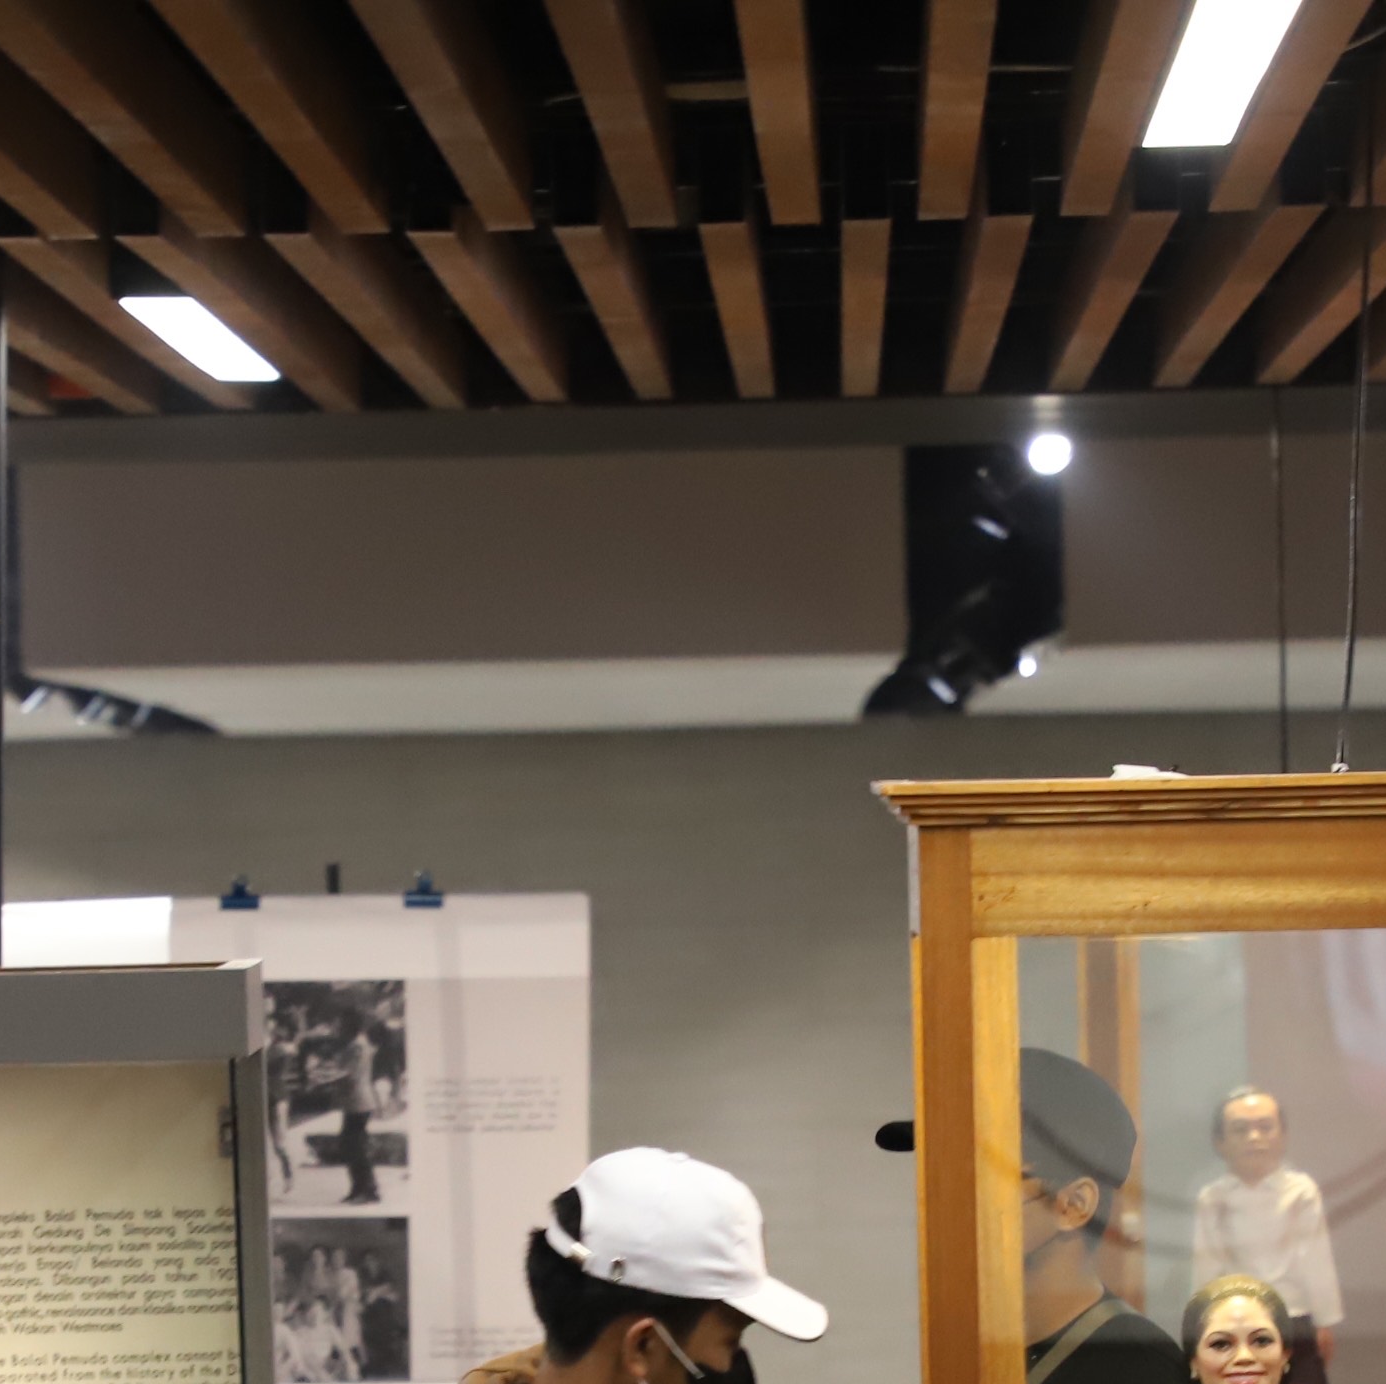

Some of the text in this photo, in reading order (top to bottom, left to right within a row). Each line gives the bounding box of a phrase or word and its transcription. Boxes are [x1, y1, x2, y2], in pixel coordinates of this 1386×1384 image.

[100, 1367, 121, 1379] the
[179, 1365, 195, 1378] of
[200, 1364, 221, 1377] the
